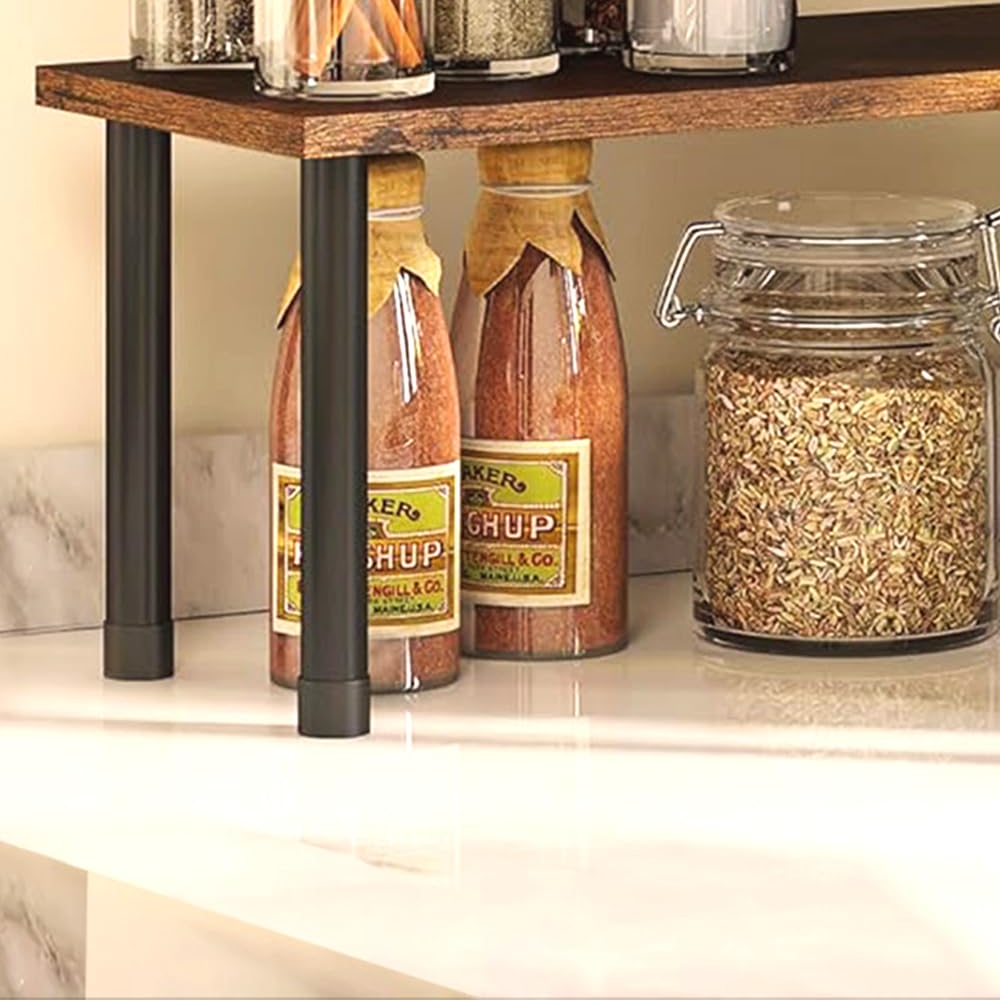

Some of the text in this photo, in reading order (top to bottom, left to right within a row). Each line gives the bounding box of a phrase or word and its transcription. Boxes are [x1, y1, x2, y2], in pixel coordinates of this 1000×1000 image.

[462, 464, 527, 494] AKER
[367, 498, 421, 522] KER
[467, 511, 555, 540] CHUP
[518, 553, 529, 567] &
[412, 581, 423, 595] &
